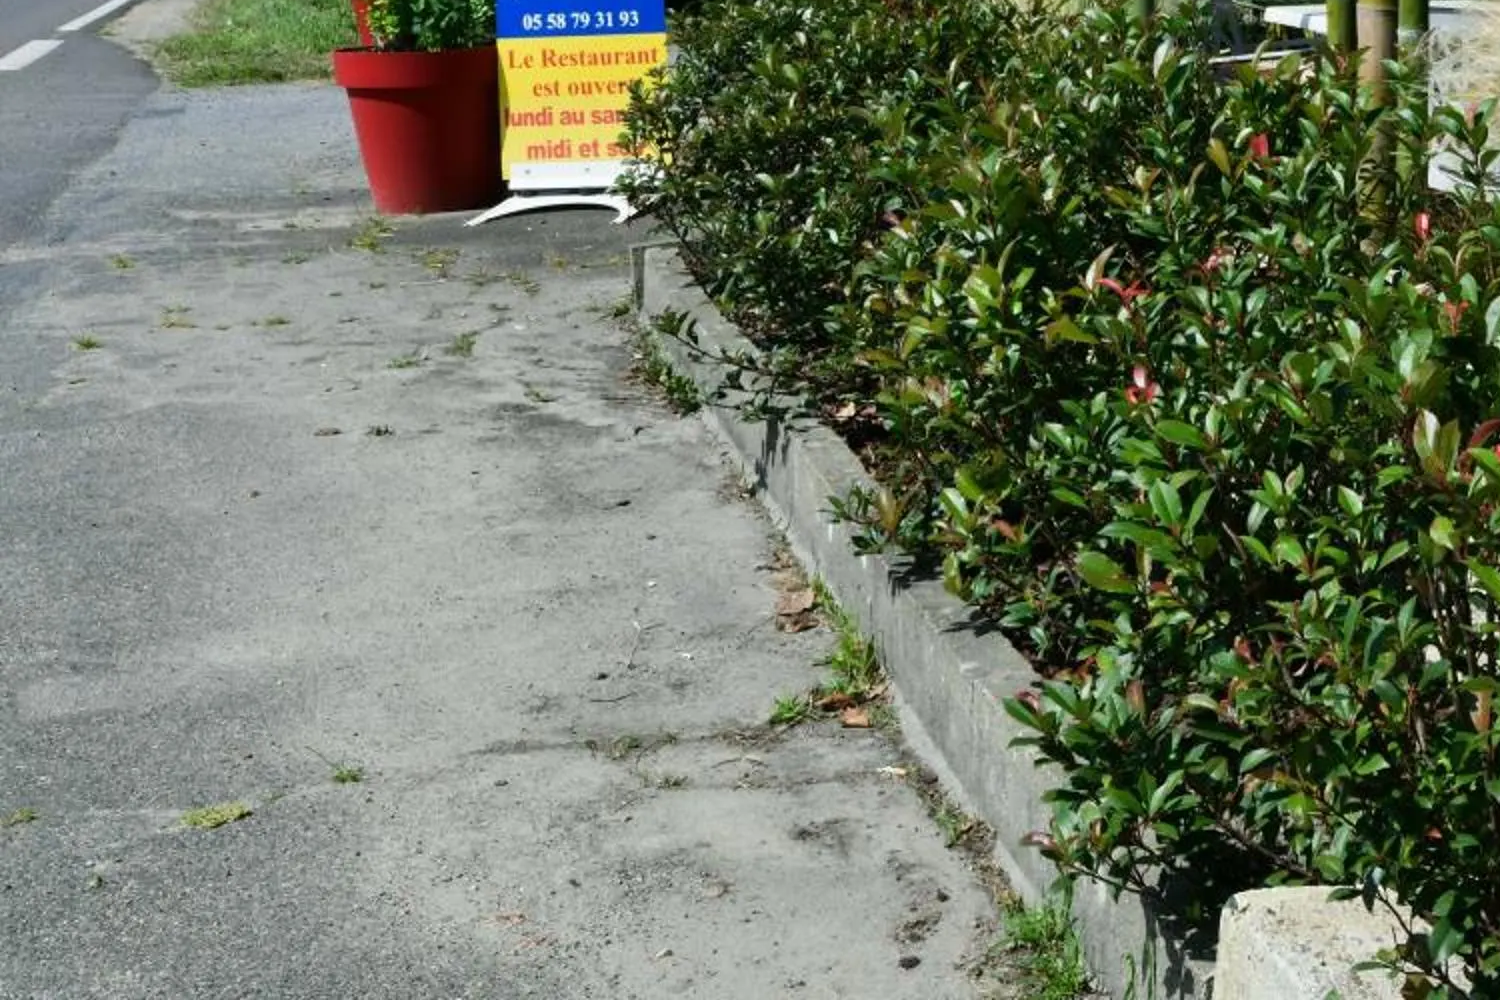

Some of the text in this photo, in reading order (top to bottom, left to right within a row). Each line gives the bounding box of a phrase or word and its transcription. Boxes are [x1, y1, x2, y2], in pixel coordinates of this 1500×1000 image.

[522, 10, 639, 31] 05 58 79 31 93
[508, 47, 658, 69] Le Restaurant
[533, 80, 561, 97] est
[504, 106, 553, 128] lundi
[560, 109, 585, 125] au
[527, 140, 571, 160] midi
[579, 139, 600, 158] et
